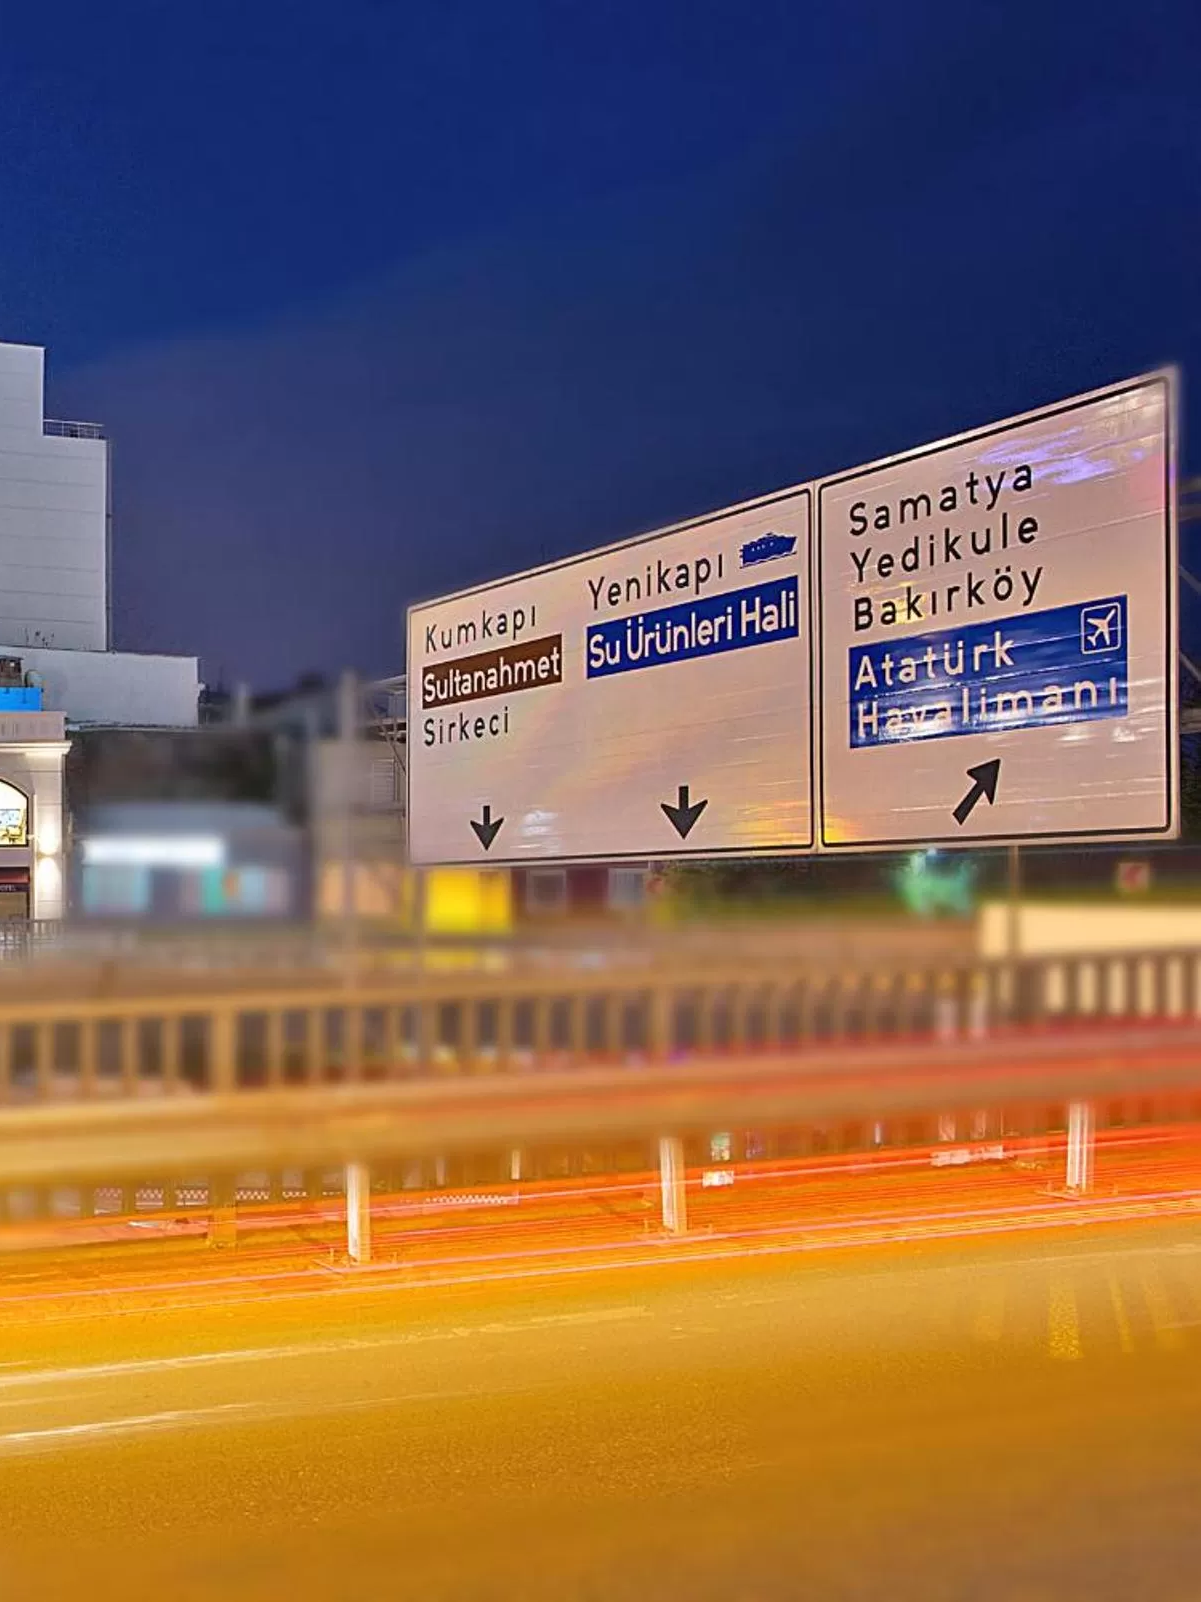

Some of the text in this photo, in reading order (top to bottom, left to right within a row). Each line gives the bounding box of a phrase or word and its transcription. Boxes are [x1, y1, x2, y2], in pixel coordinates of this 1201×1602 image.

[849, 464, 1033, 536] Samatya
[850, 512, 1039, 583] Yedikule
[588, 553, 724, 611] Yenikapı
[854, 566, 1043, 631] Bakırköy
[425, 605, 536, 654] Kumkapı
[589, 590, 796, 669] Su Ürünleri Hali
[423, 650, 561, 703] Sultanahmet
[854, 631, 1016, 691] Atatürk
[423, 706, 511, 748] Sirkeci
[857, 676, 1118, 738] Havalimanı
